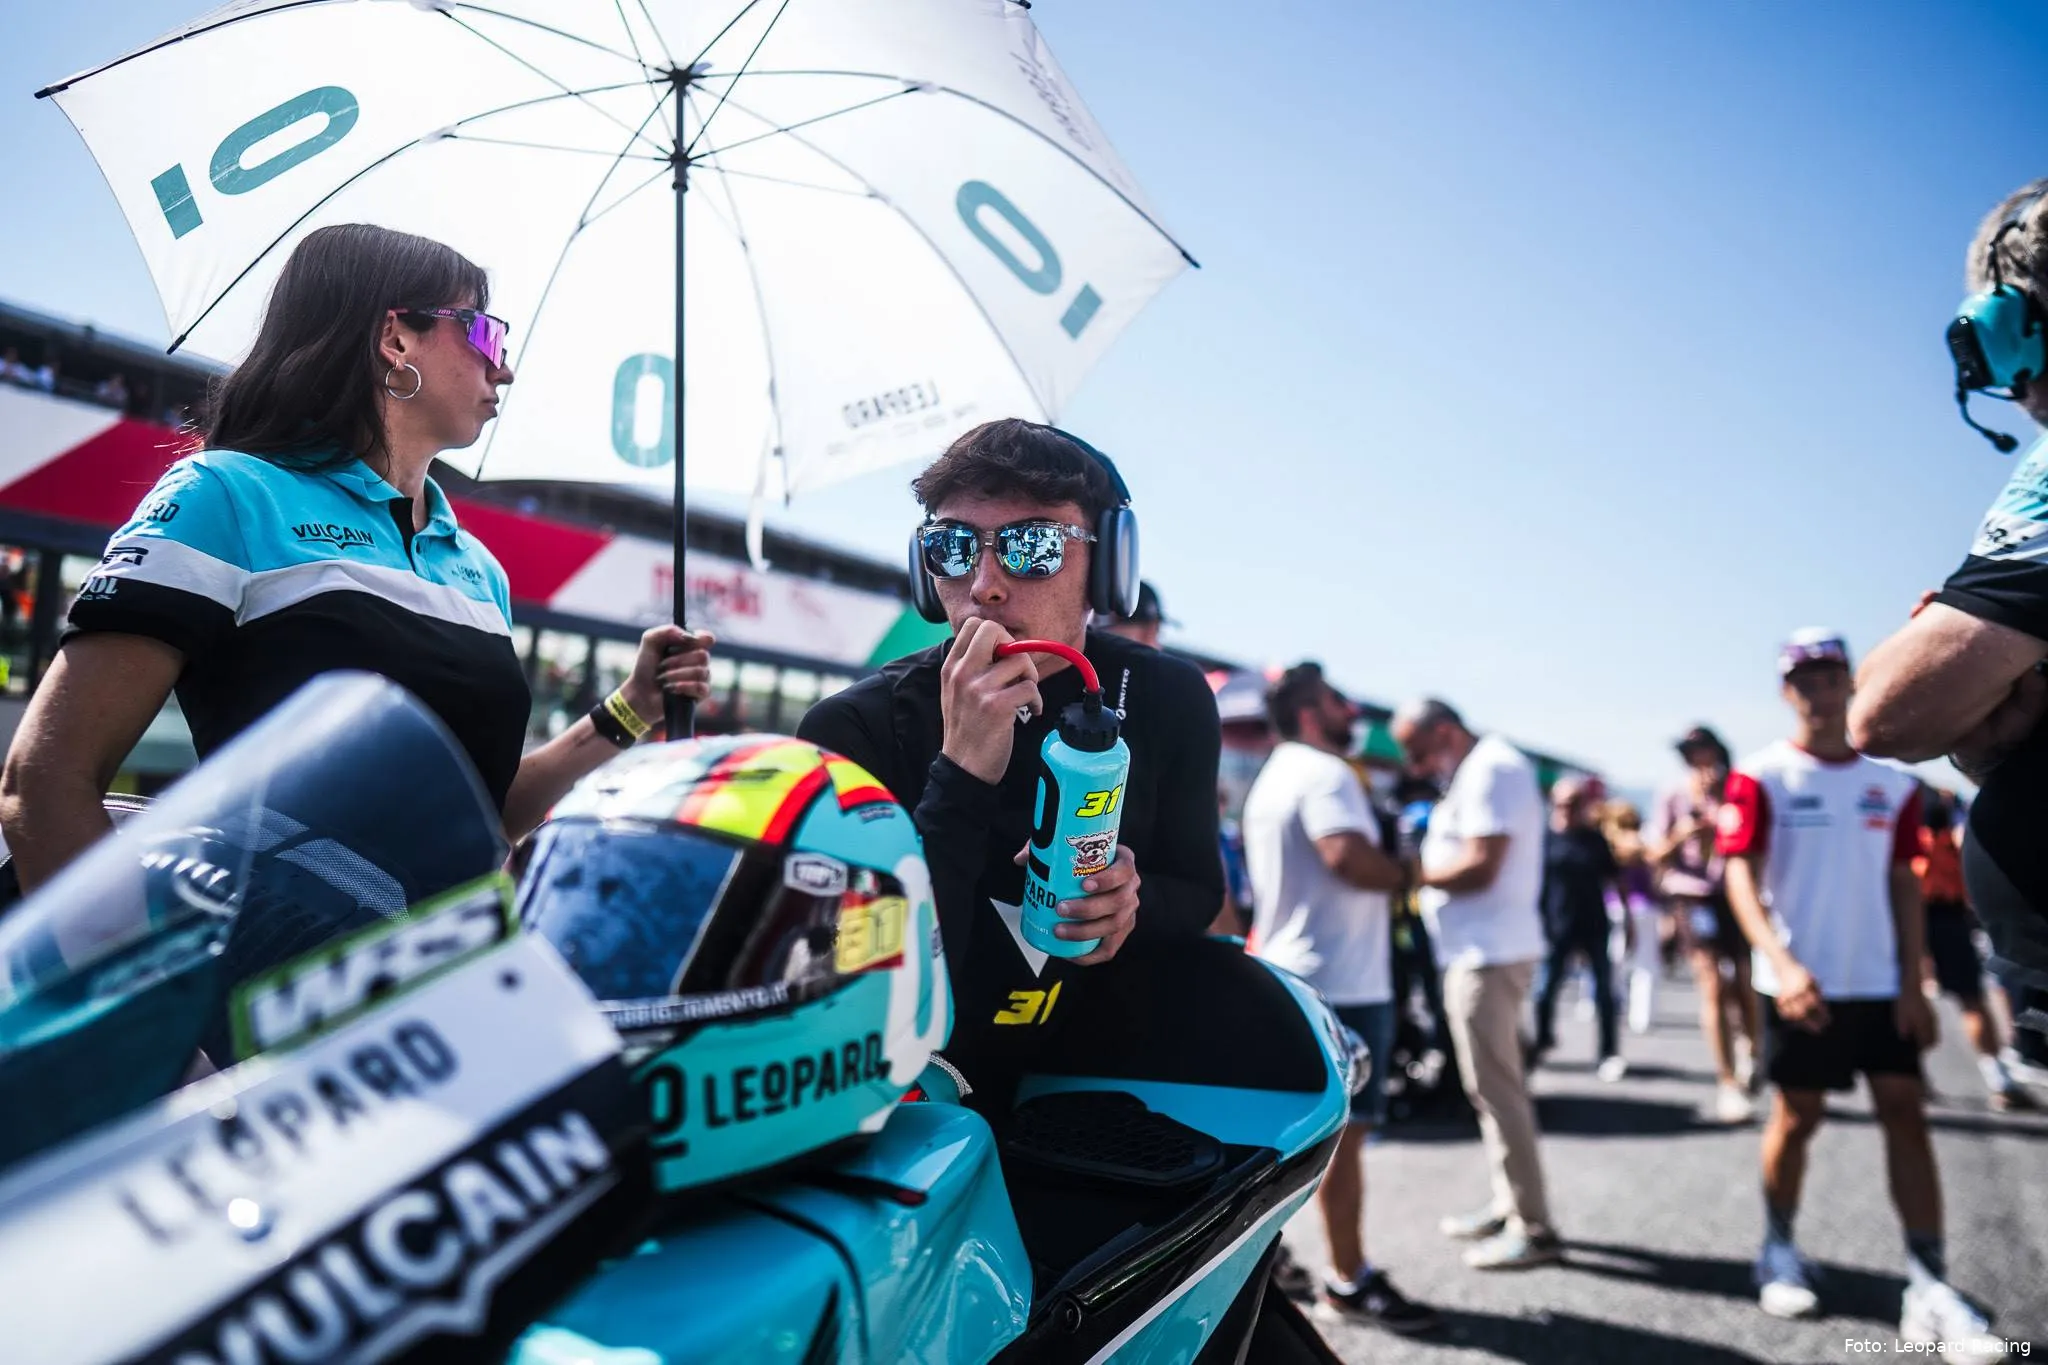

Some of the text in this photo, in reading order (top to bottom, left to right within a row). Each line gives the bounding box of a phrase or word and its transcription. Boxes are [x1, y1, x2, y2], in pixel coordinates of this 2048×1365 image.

[291, 523, 375, 545] VULCAIN
[1075, 783, 1124, 818] 31
[993, 980, 1063, 1025] 31
[704, 1032, 884, 1128] LEOPARD
